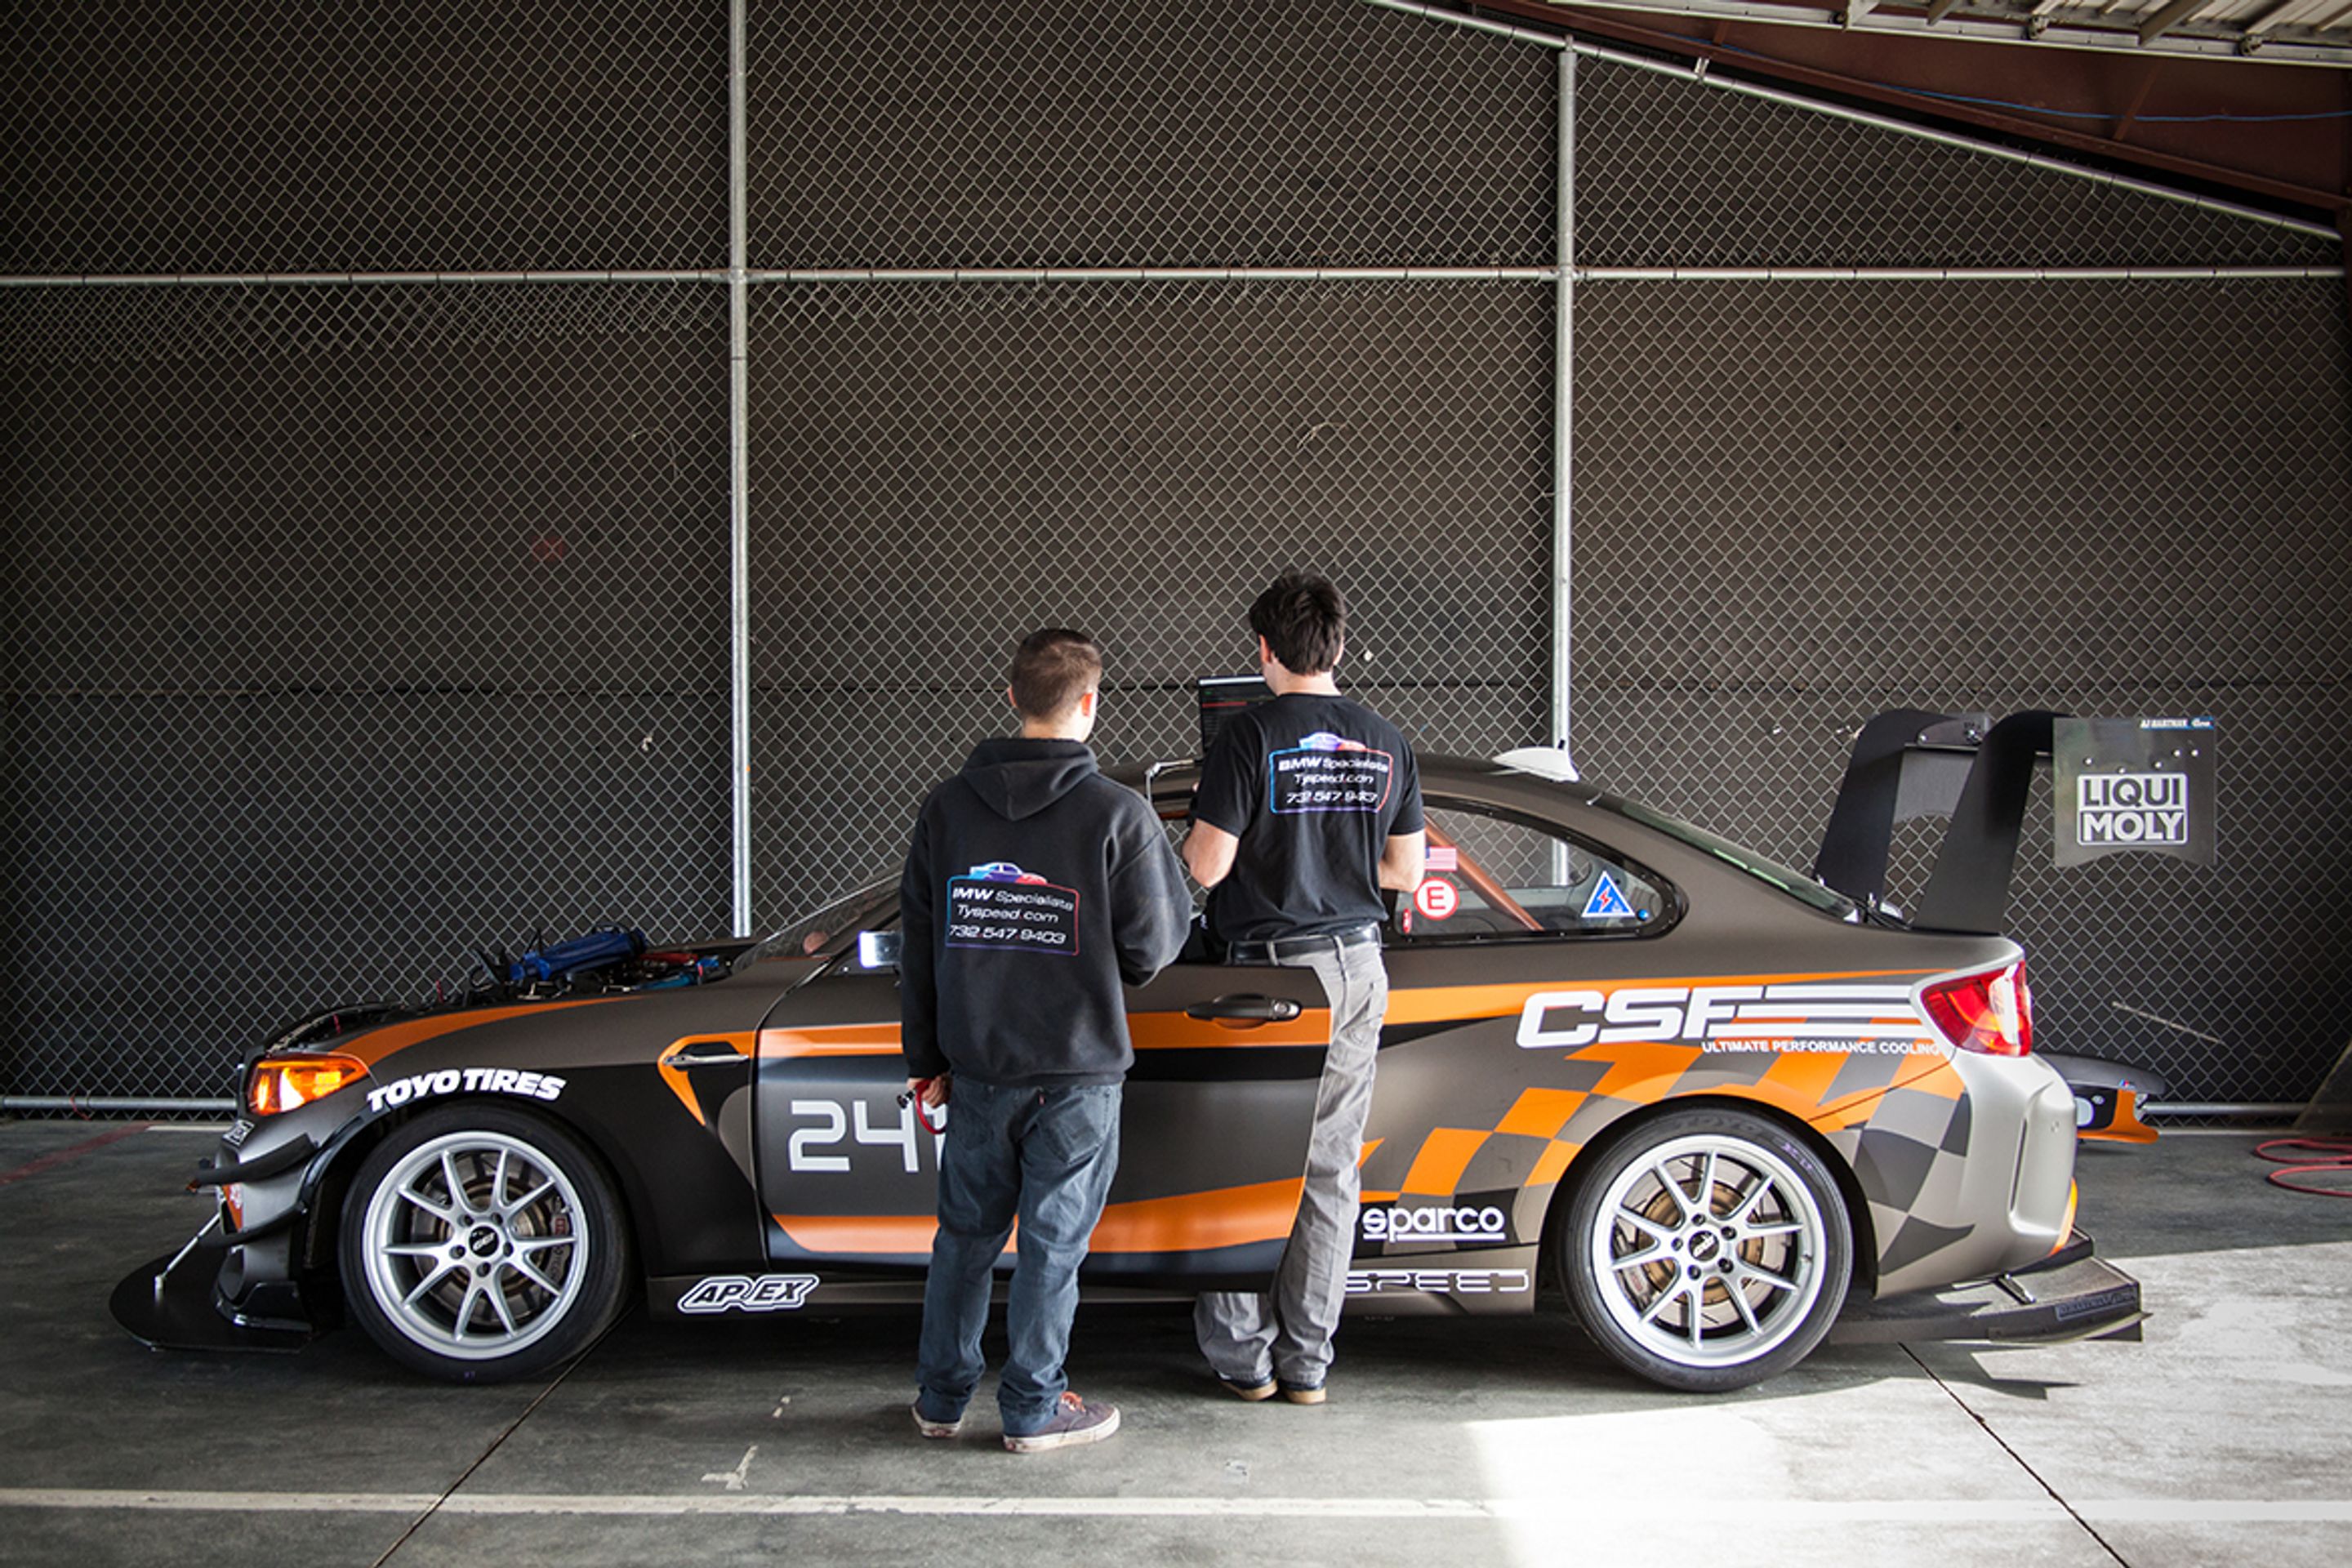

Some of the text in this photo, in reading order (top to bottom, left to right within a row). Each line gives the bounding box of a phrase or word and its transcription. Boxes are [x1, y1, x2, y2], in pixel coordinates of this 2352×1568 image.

[1278, 756, 1322, 771] BMW
[2084, 778, 2180, 807] LIQUI
[2082, 812, 2184, 841] MOLY
[1427, 886, 1446, 910] E
[1516, 986, 1763, 1049] CSF
[1701, 1040, 1941, 1056] ULTIMATE PERFORMANCE COOLING
[367, 1067, 568, 1112] TOYO TIRES
[1362, 1207, 1505, 1243] sparco
[686, 1278, 813, 1308] APEX
